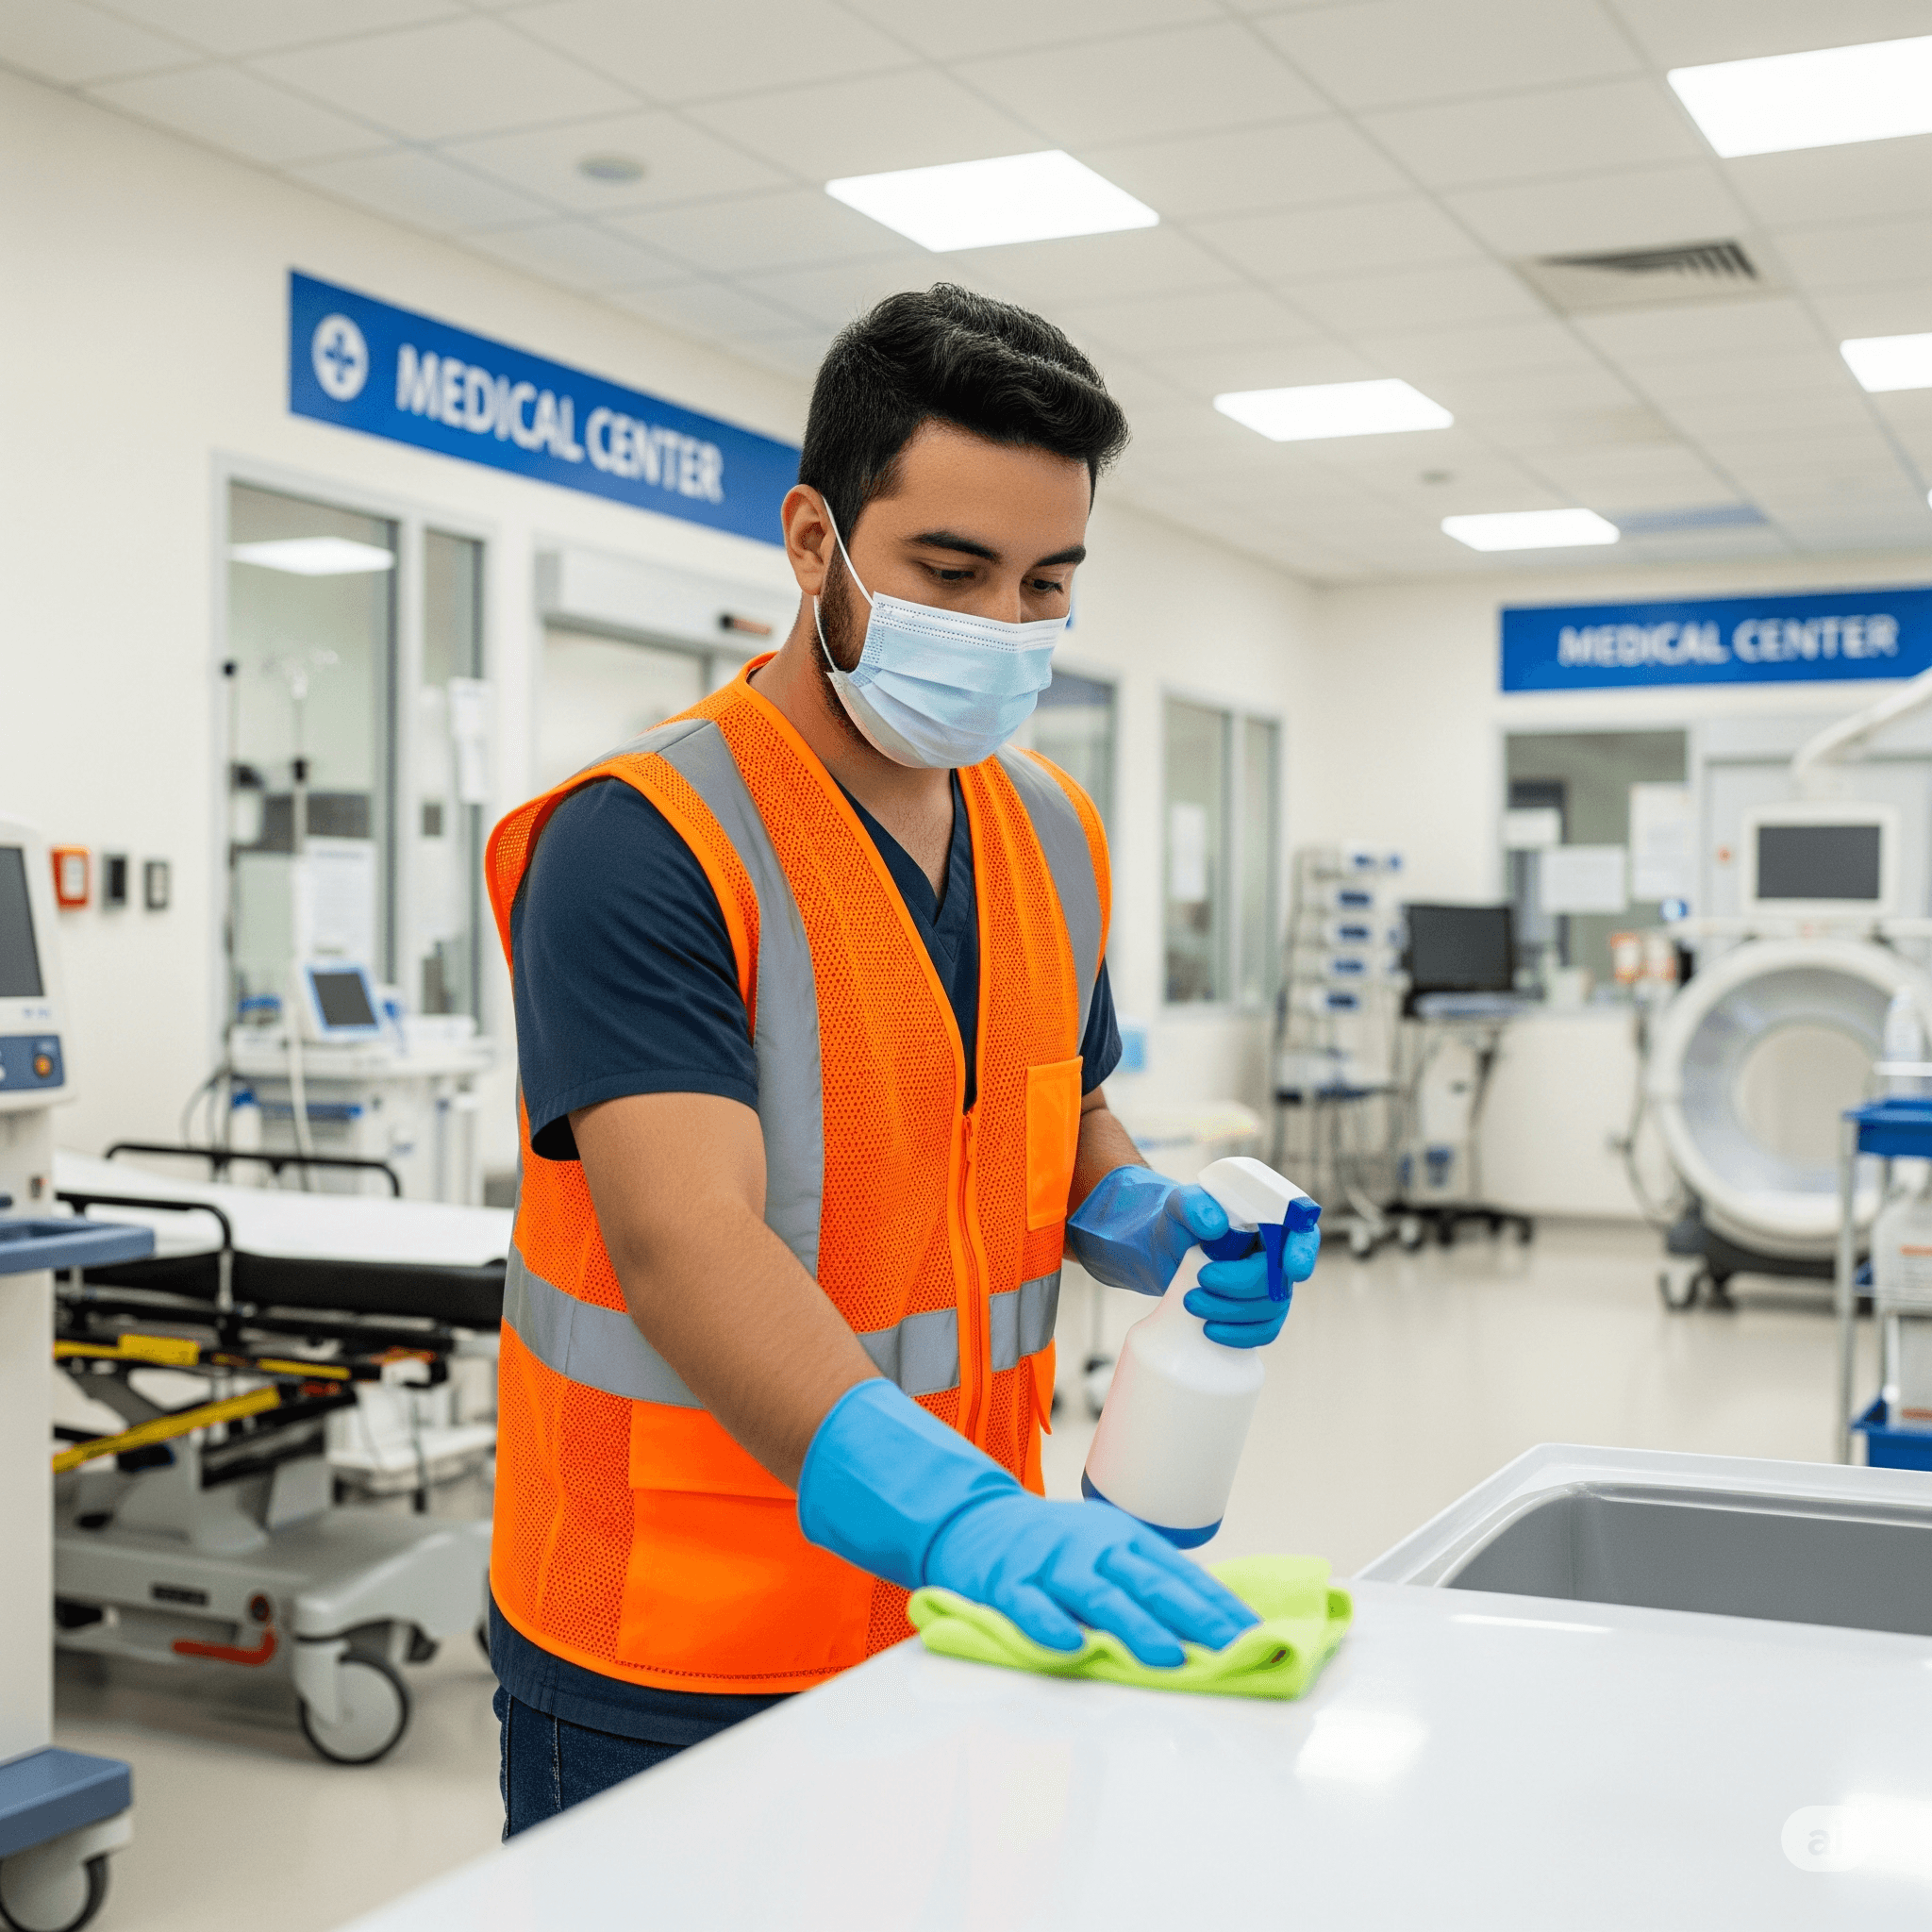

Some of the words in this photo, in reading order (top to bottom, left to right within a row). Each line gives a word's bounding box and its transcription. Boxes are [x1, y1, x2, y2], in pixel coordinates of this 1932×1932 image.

[396, 342, 584, 463] MEDICAL
[586, 406, 724, 503] CENTER
[1557, 621, 1731, 667] MEDICAL
[1733, 614, 1899, 663] CENTER
